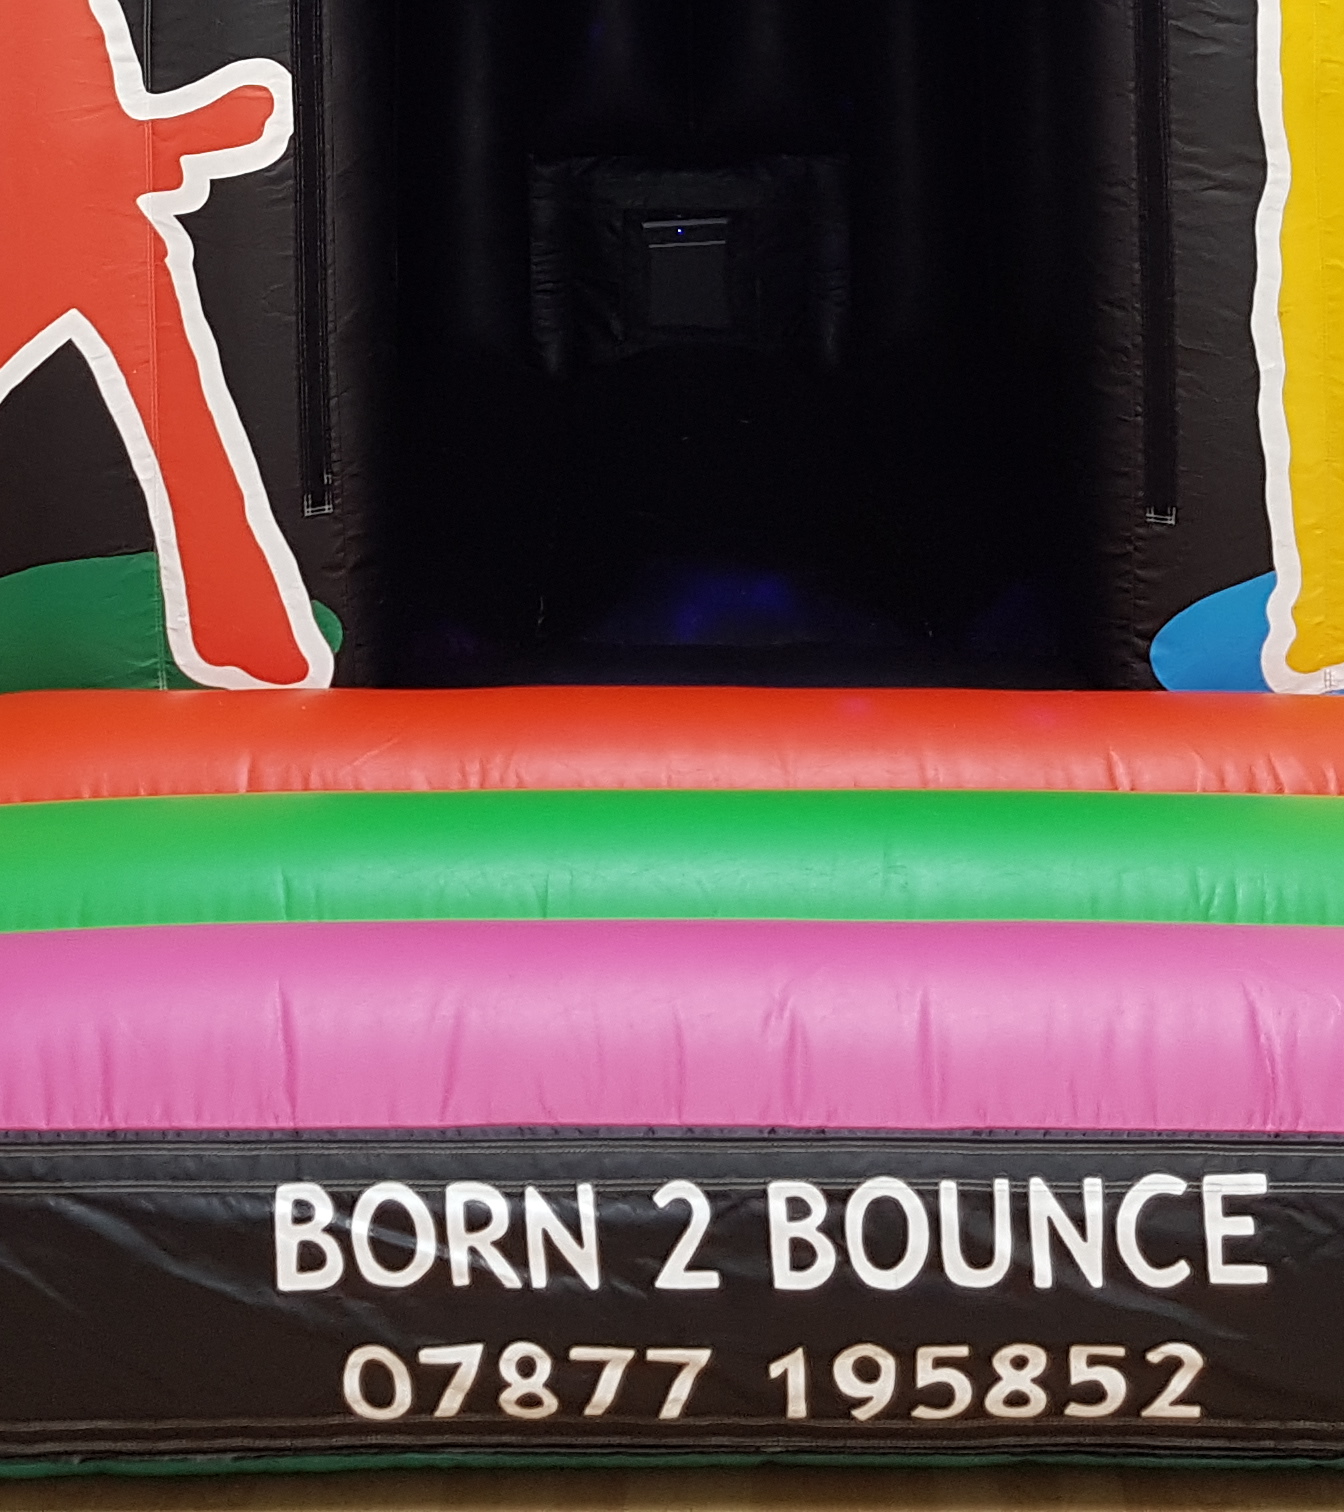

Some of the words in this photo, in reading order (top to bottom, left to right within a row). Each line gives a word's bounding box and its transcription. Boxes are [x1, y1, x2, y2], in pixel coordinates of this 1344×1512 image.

[273, 1180, 602, 1292] BORN
[652, 1180, 721, 1291] 2
[766, 1173, 1270, 1291] BOUNCE
[342, 1342, 713, 1421] 07877
[766, 1342, 1205, 1423] 195852
